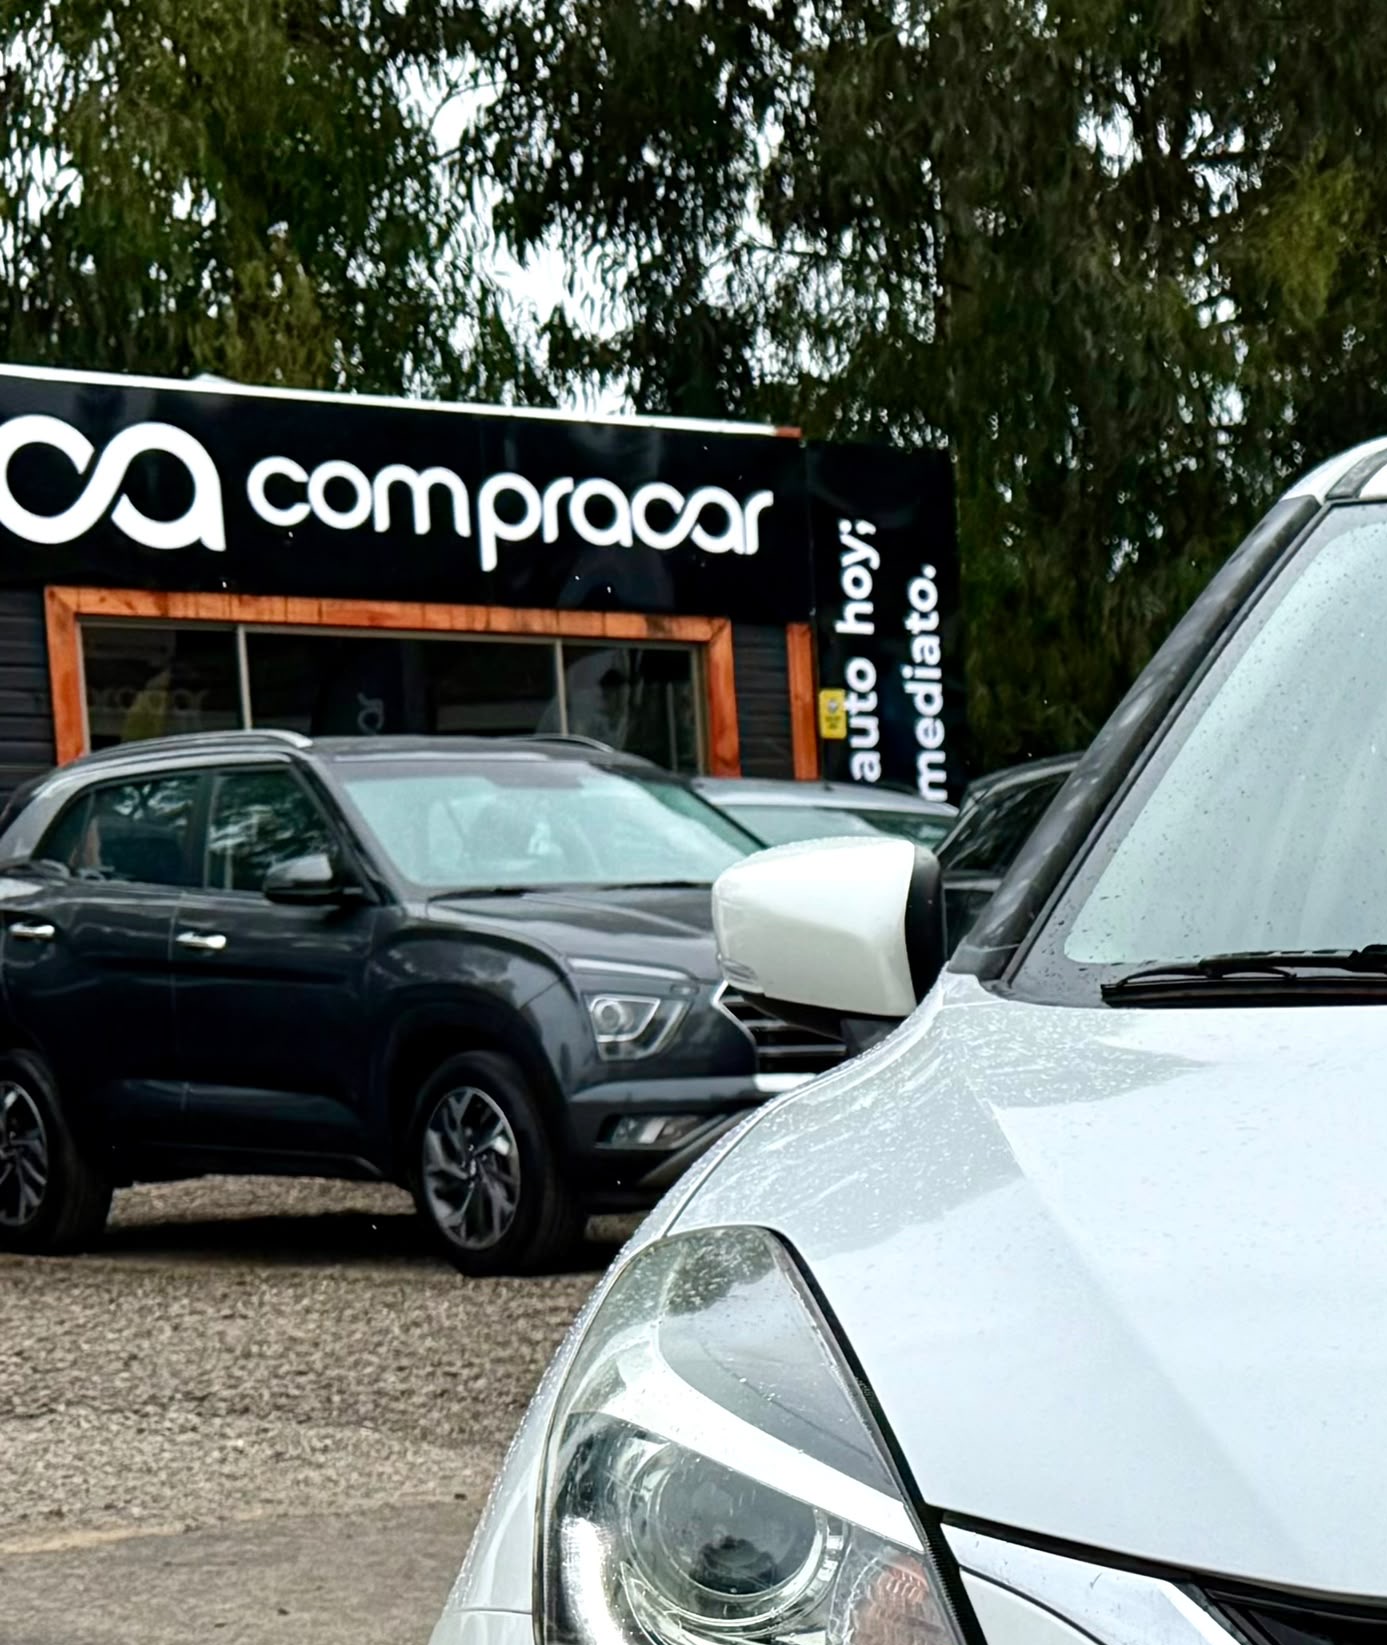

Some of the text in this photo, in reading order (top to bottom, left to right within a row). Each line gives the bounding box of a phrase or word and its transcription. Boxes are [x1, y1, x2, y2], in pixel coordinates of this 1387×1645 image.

[246, 456, 774, 572] compracar
[834, 518, 882, 783] auto hoy;
